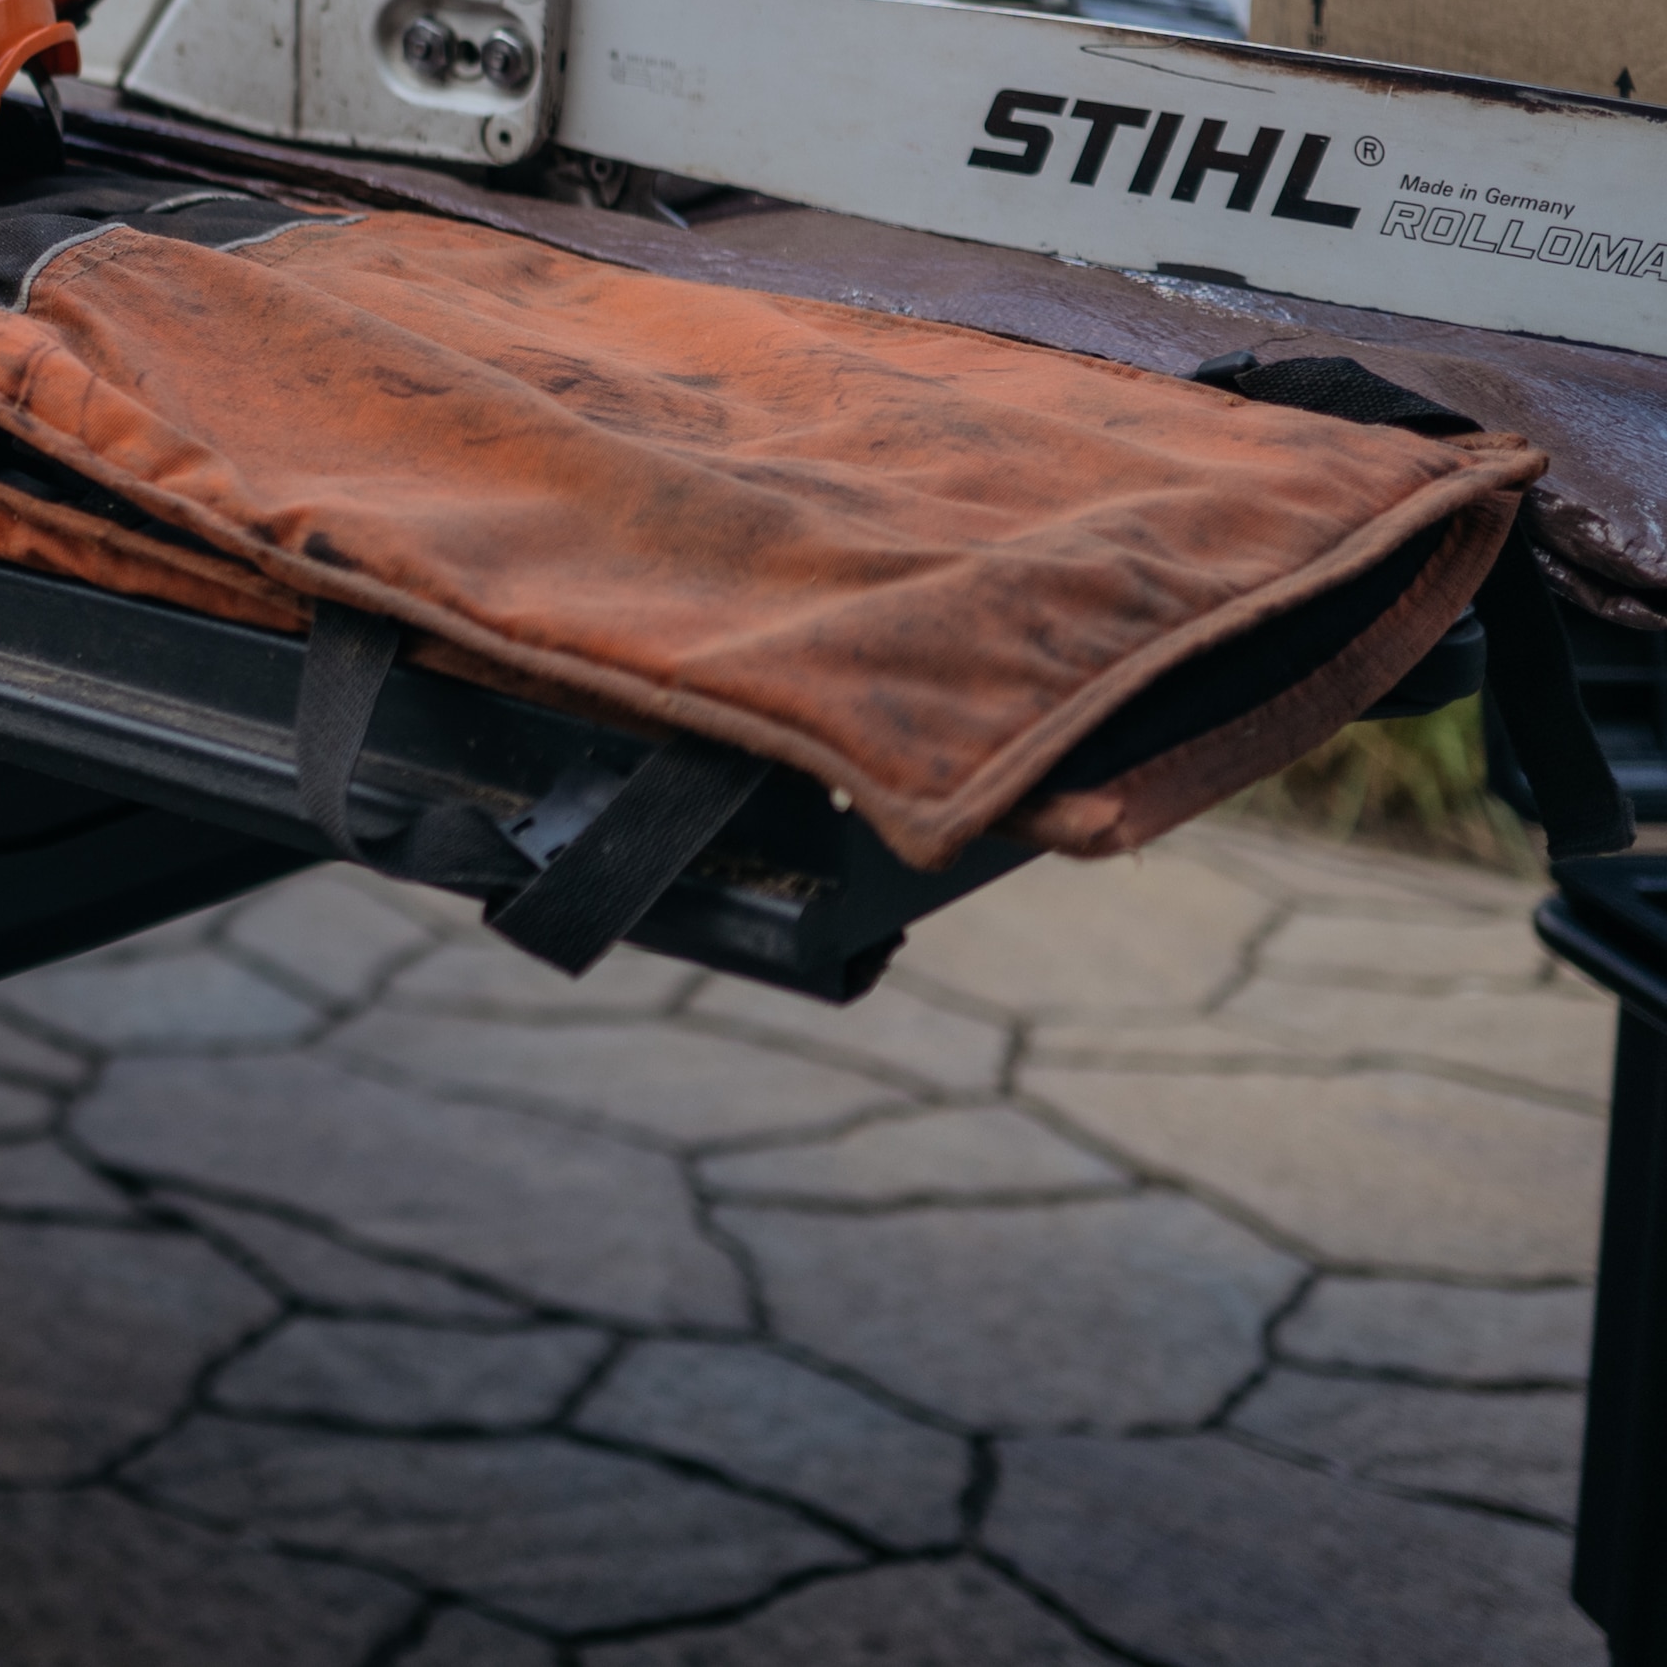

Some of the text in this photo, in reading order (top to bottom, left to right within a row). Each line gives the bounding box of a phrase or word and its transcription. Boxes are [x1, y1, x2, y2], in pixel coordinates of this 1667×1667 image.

[967, 88, 1362, 231] STIHL
[1399, 174, 1576, 220] Made in Germany
